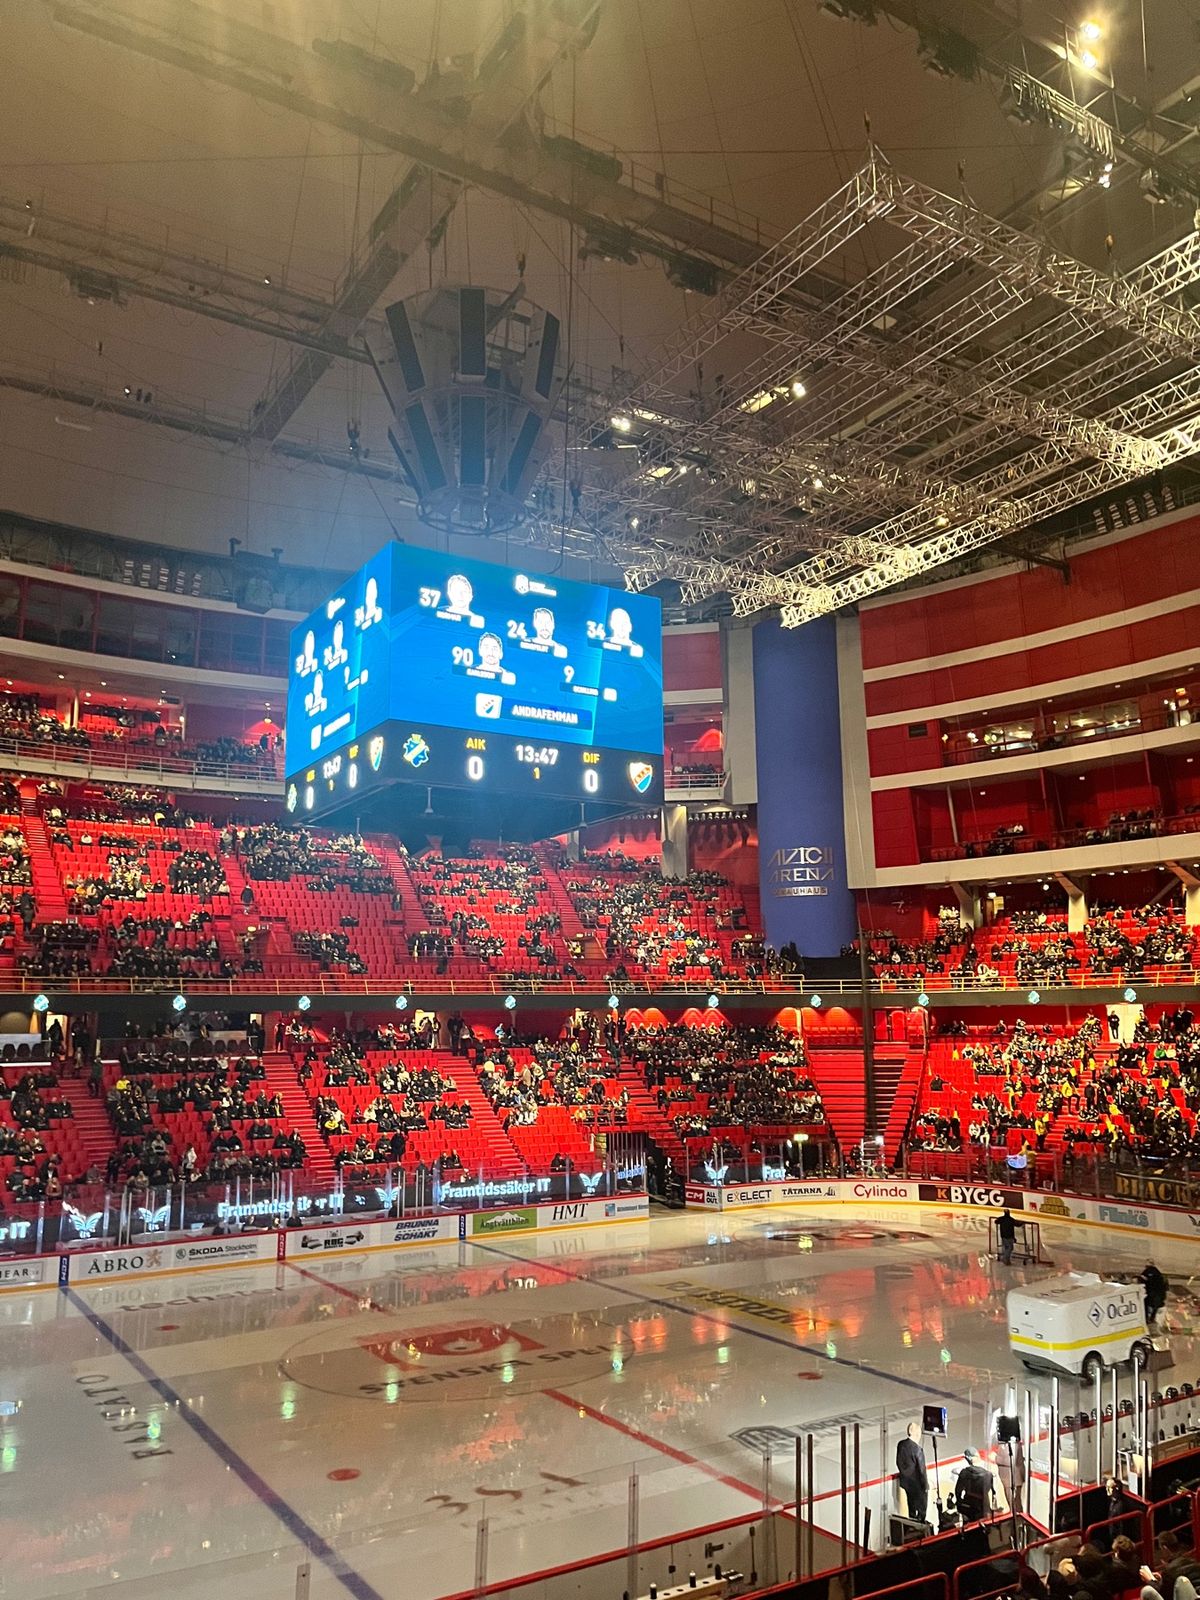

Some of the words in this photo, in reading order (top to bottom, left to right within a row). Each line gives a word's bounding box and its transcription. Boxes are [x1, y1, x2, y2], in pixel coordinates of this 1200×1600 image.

[420, 587, 441, 608] 37
[507, 620, 527, 641] 24
[587, 620, 606, 640] 34
[452, 646, 473, 666] 90
[564, 665, 575, 683] 9
[511, 705, 579, 724] ANDRAFEMMAN
[466, 737, 486, 751] AIK
[516, 745, 559, 765] 13:47
[583, 752, 600, 764] DIF
[467, 756, 484, 780] 0
[533, 767, 540, 779] 1
[584, 769, 599, 793] 0
[768, 867, 835, 883] ARENA
[441, 1179, 535, 1199] Framtidssäker
[537, 1178, 551, 1192] IT
[854, 1183, 908, 1198] Cylinda
[937, 1188, 949, 1199] K
[951, 1186, 1005, 1206] BYGG
[218, 1195, 327, 1218] Framtidsskr
[553, 1203, 589, 1220] HMT
[10, 1221, 31, 1239] IT
[395, 1218, 440, 1230] BRUNNA
[394, 1230, 438, 1242] SCHAKT
[188, 1246, 224, 1257] ŠKODA
[225, 1243, 258, 1252] Stockholm
[0, 1268, 29, 1279] EAR
[88, 1255, 144, 1274] ÅBRO
[1107, 1300, 1138, 1320] Ocab
[796, 1413, 864, 1433] HOCKEY
